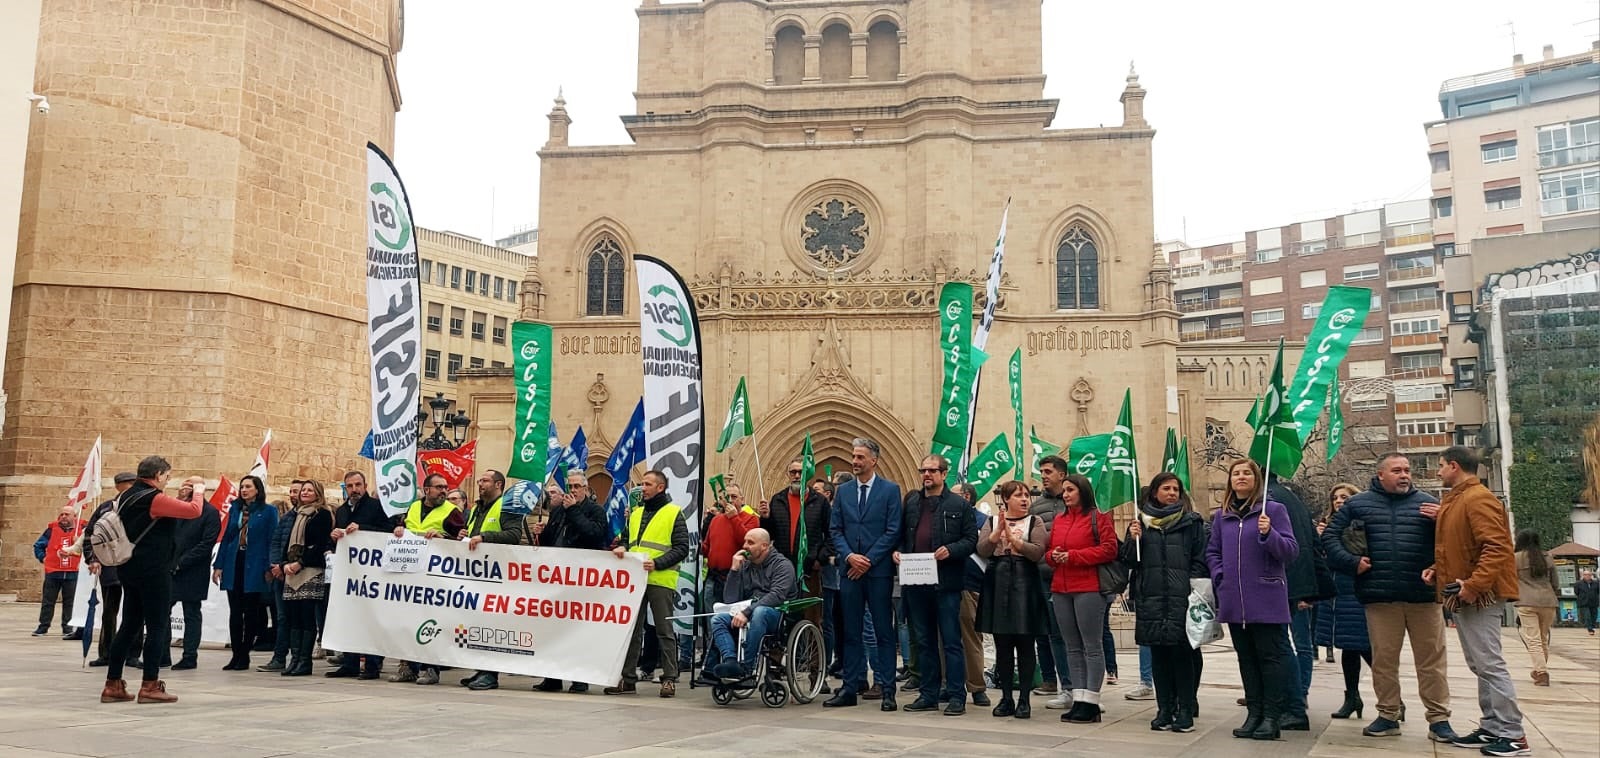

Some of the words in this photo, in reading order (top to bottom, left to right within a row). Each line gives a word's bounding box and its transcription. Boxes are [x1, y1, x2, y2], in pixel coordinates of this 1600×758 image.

[594, 331, 640, 355] maria
[348, 546, 383, 567] POR
[428, 554, 503, 580] POLICÍA
[508, 562, 532, 582] DE
[538, 564, 635, 593] CALIDAD,
[346, 575, 379, 599] MÁS
[384, 583, 479, 610] INVERSIÓN
[483, 594, 510, 613] EN
[513, 597, 631, 624] SEGURIDAD
[468, 626, 533, 647] SPPLB
